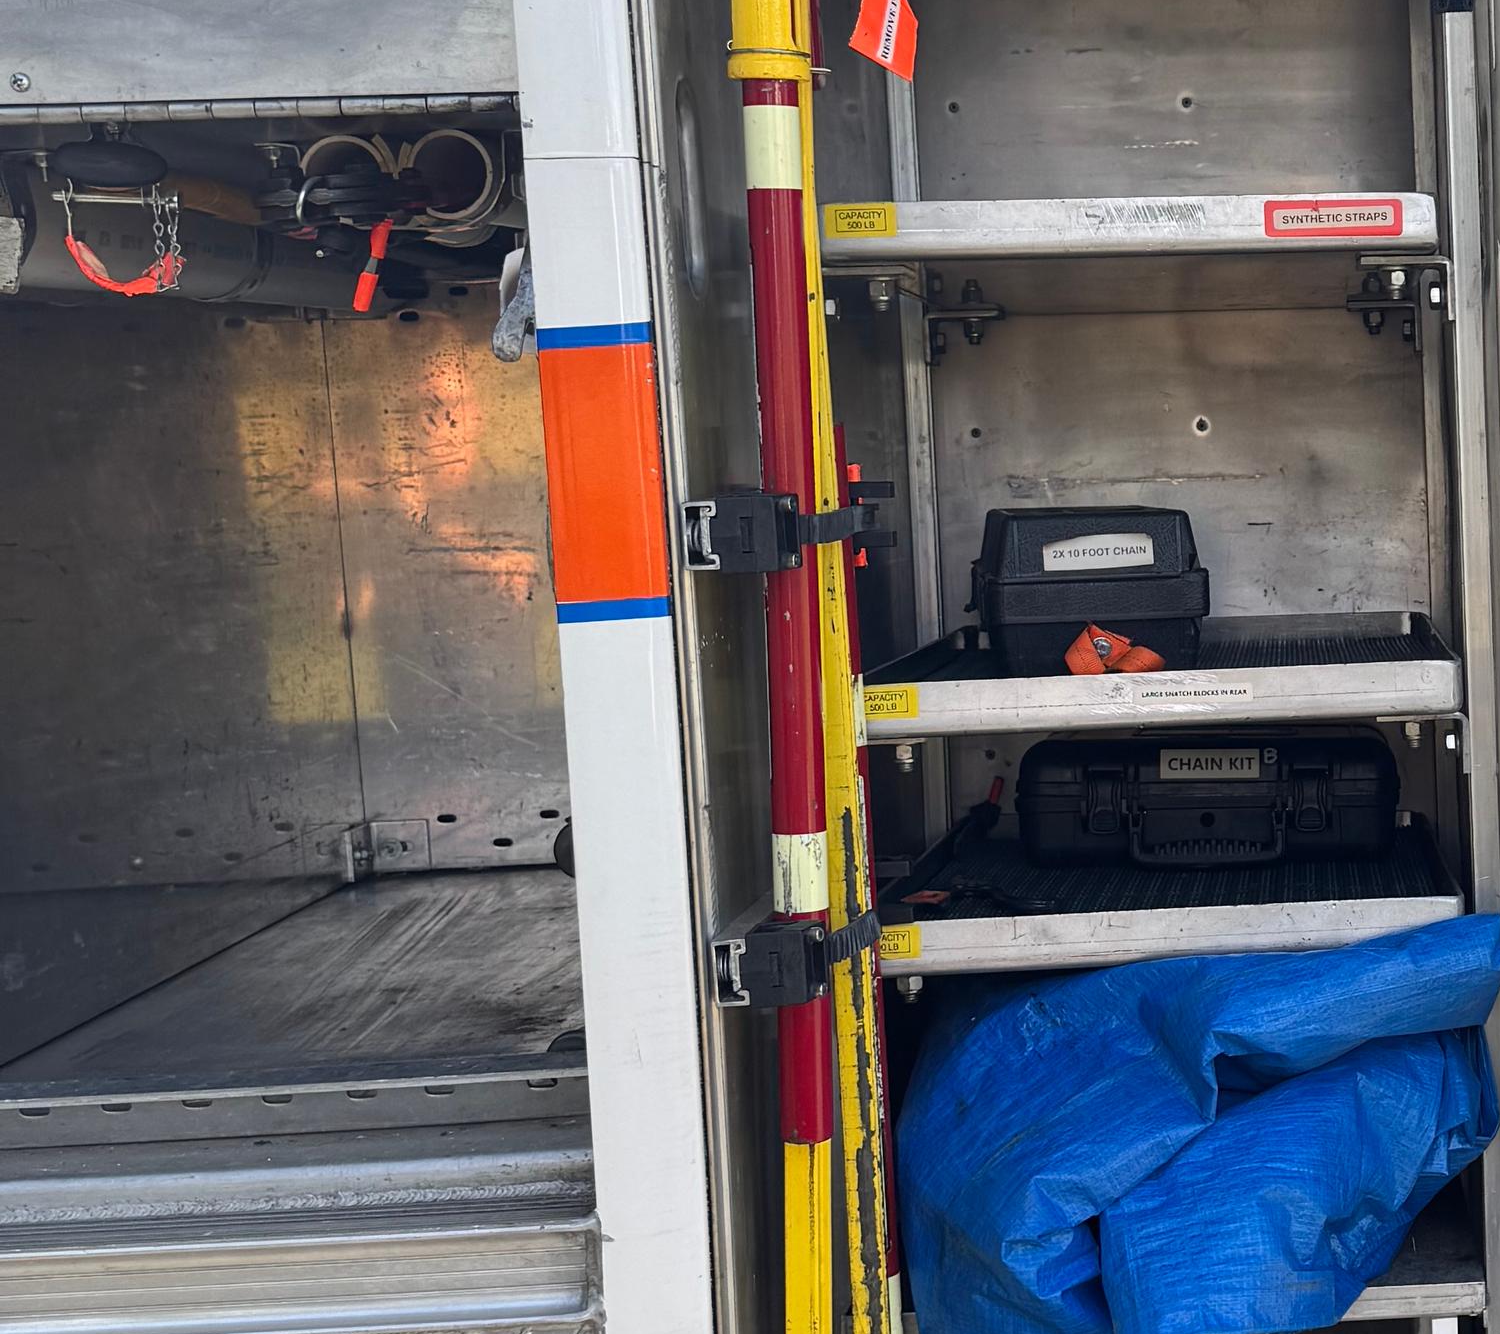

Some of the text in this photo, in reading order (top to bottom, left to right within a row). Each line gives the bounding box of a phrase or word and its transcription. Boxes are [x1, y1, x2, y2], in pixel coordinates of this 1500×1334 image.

[881, 8, 897, 59] REMOVE
[838, 210, 883, 220] CAPACITY
[1282, 211, 1388, 225] SYNTHETIC STRAPS
[847, 220, 875, 229] 500 LB
[1052, 545, 1147, 559] 2X 10 FOOT CHAIN
[1193, 689, 1219, 697] BLOCKS
[870, 702, 897, 712] 500 LB
[1263, 747, 1278, 764] B
[1168, 757, 1256, 771] CHAIN KIT
[881, 933, 907, 942] ACITY
[888, 942, 899, 951] LB
